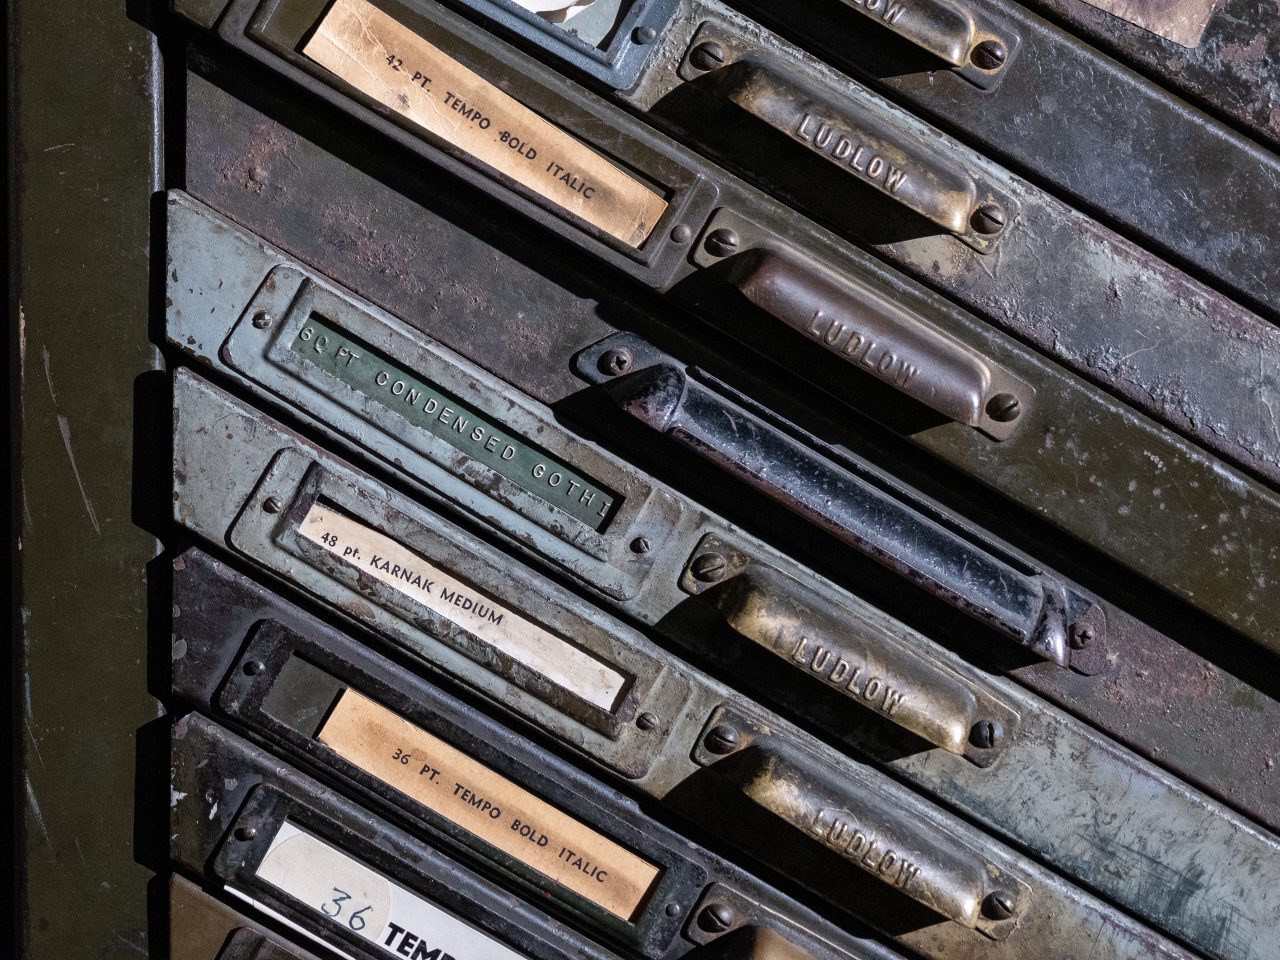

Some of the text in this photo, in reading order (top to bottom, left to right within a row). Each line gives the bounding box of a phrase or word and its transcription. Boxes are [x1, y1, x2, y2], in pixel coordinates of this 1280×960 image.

[385, 53, 405, 72] 42
[442, 91, 492, 132] TEMPO
[499, 130, 538, 161] BOLD
[546, 161, 597, 200] ITALIC
[794, 113, 908, 194] LUDLOW
[805, 310, 920, 390] LUDLOW
[334, 346, 361, 368] PT
[375, 370, 517, 461] CONDENSED
[320, 531, 338, 548] 48
[369, 554, 435, 594] KARNAK
[440, 587, 504, 627] MEDIUM
[792, 636, 907, 717] LUDLOW
[391, 748, 609, 884] 36 PT. TEMPO BOLD ITALIC
[808, 810, 920, 890] LUDLOW
[320, 886, 374, 931] 36
